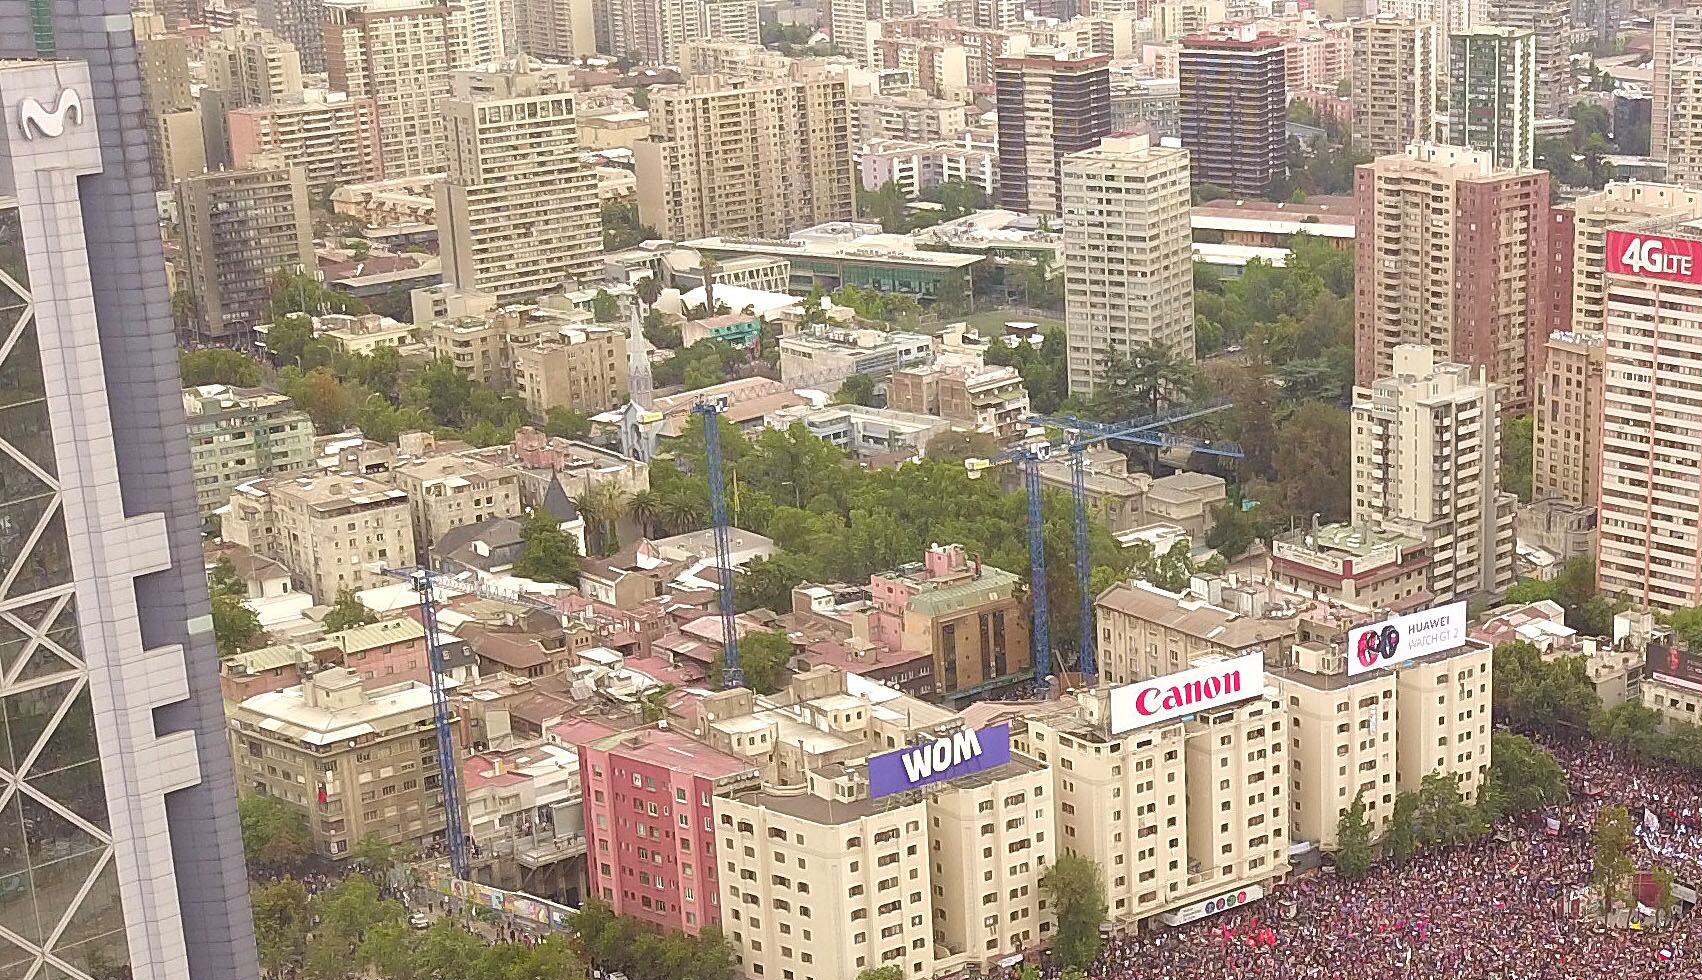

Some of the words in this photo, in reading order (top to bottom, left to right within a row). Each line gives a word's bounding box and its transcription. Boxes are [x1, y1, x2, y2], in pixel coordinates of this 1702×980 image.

[1408, 615, 1450, 635] HUAWEI
[1408, 634, 1438, 650] WATCH
[1439, 630, 1451, 642] GT
[1453, 627, 1459, 639] 2
[1135, 670, 1241, 716] Canon
[901, 727, 983, 783] WOM
